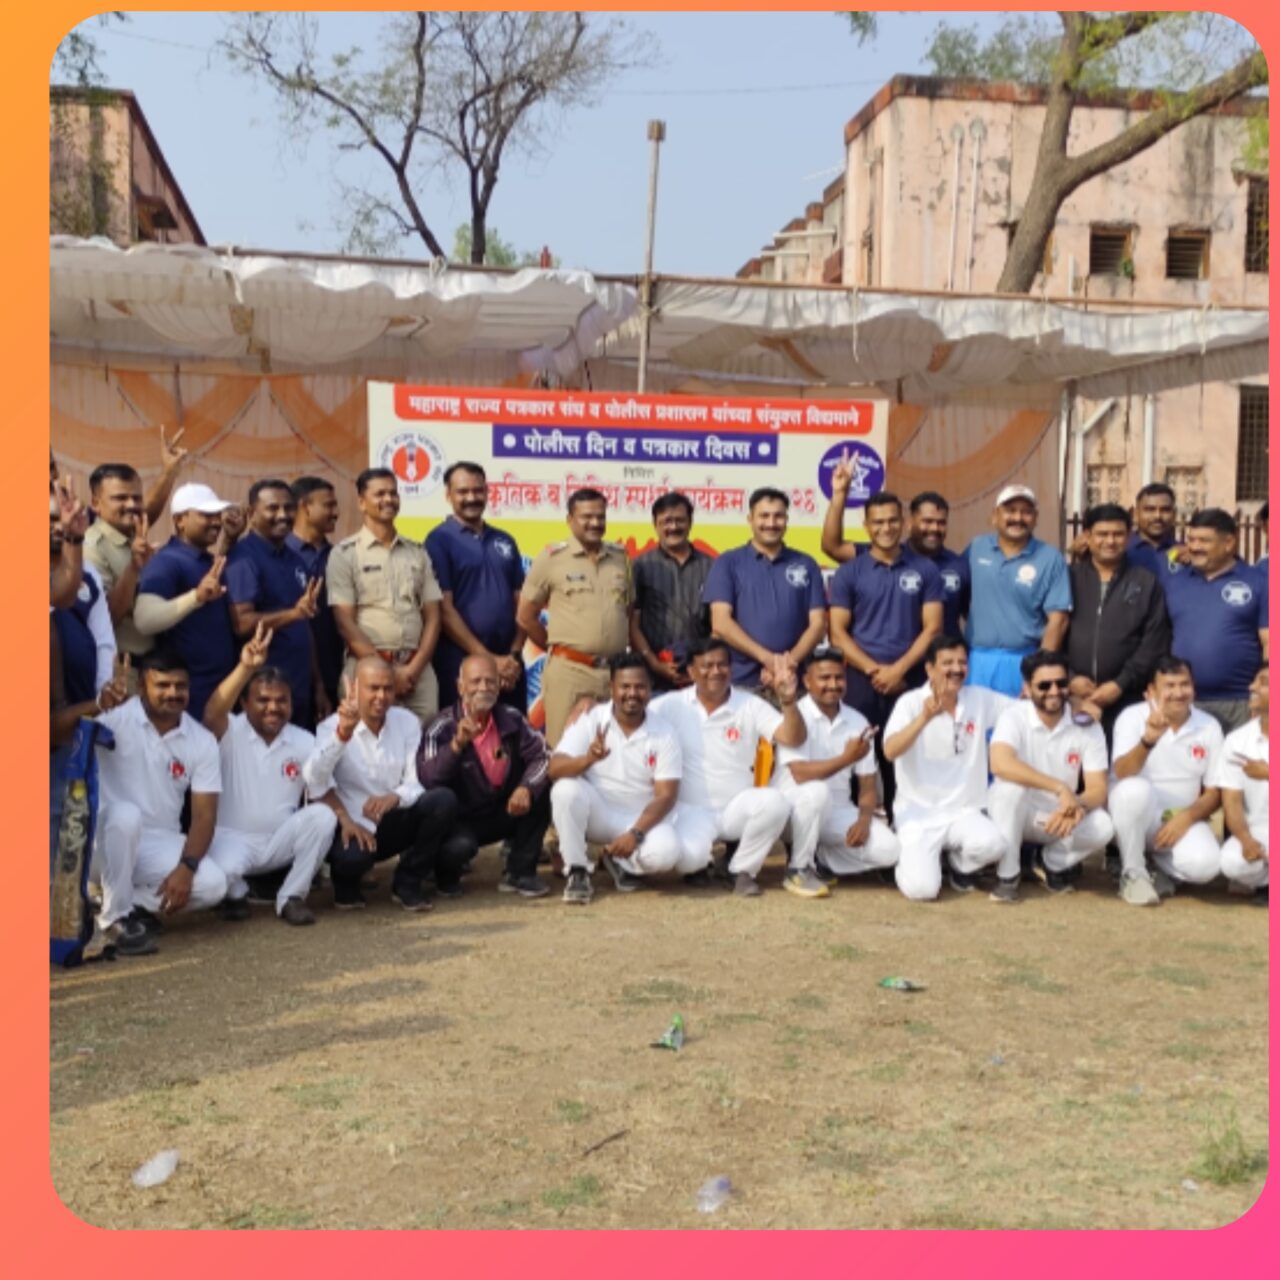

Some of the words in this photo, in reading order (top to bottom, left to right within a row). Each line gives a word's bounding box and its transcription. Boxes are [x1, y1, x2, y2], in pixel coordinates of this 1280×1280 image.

[506, 399, 555, 417] पत्रकार
[605, 399, 650, 419] पोलीस
[524, 428, 580, 453] पोलीस
[586, 429, 617, 457] दिन
[624, 437, 636, 455] व
[642, 437, 700, 458] पत्रकार
[705, 435, 752, 460] दिवस
